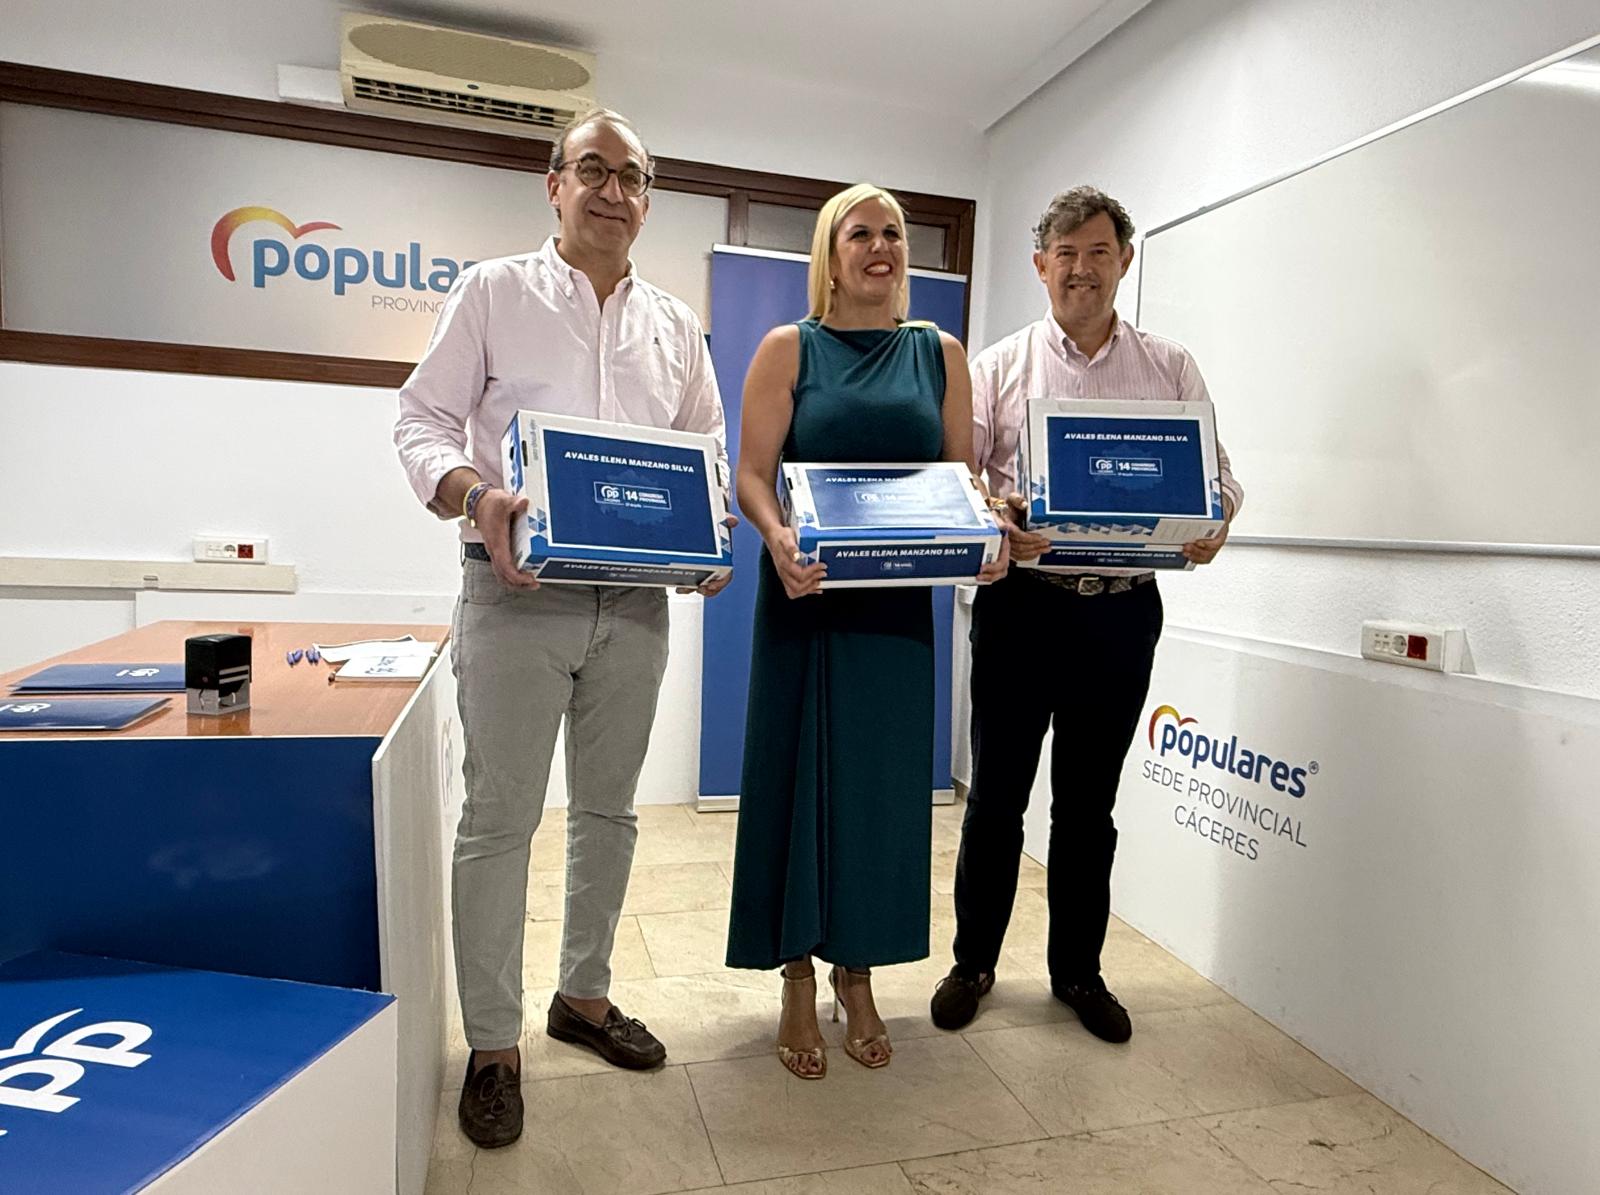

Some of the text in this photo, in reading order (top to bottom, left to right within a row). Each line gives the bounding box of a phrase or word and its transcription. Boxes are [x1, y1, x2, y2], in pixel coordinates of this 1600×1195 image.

[1064, 432, 1096, 440] AVALES
[1123, 434, 1163, 442] MANZANO
[564, 450, 695, 473] AVALES ELENA MANZANO SILVA
[1118, 462, 1131, 471] 14
[625, 490, 639, 501] 14
[836, 550, 870, 558] AVALES
[899, 549, 942, 557] MANZANO
[1160, 723, 1307, 799] populares
[1142, 760, 1307, 848] SEDE PROVINCIAL
[1174, 805, 1260, 861] CÁCERES
